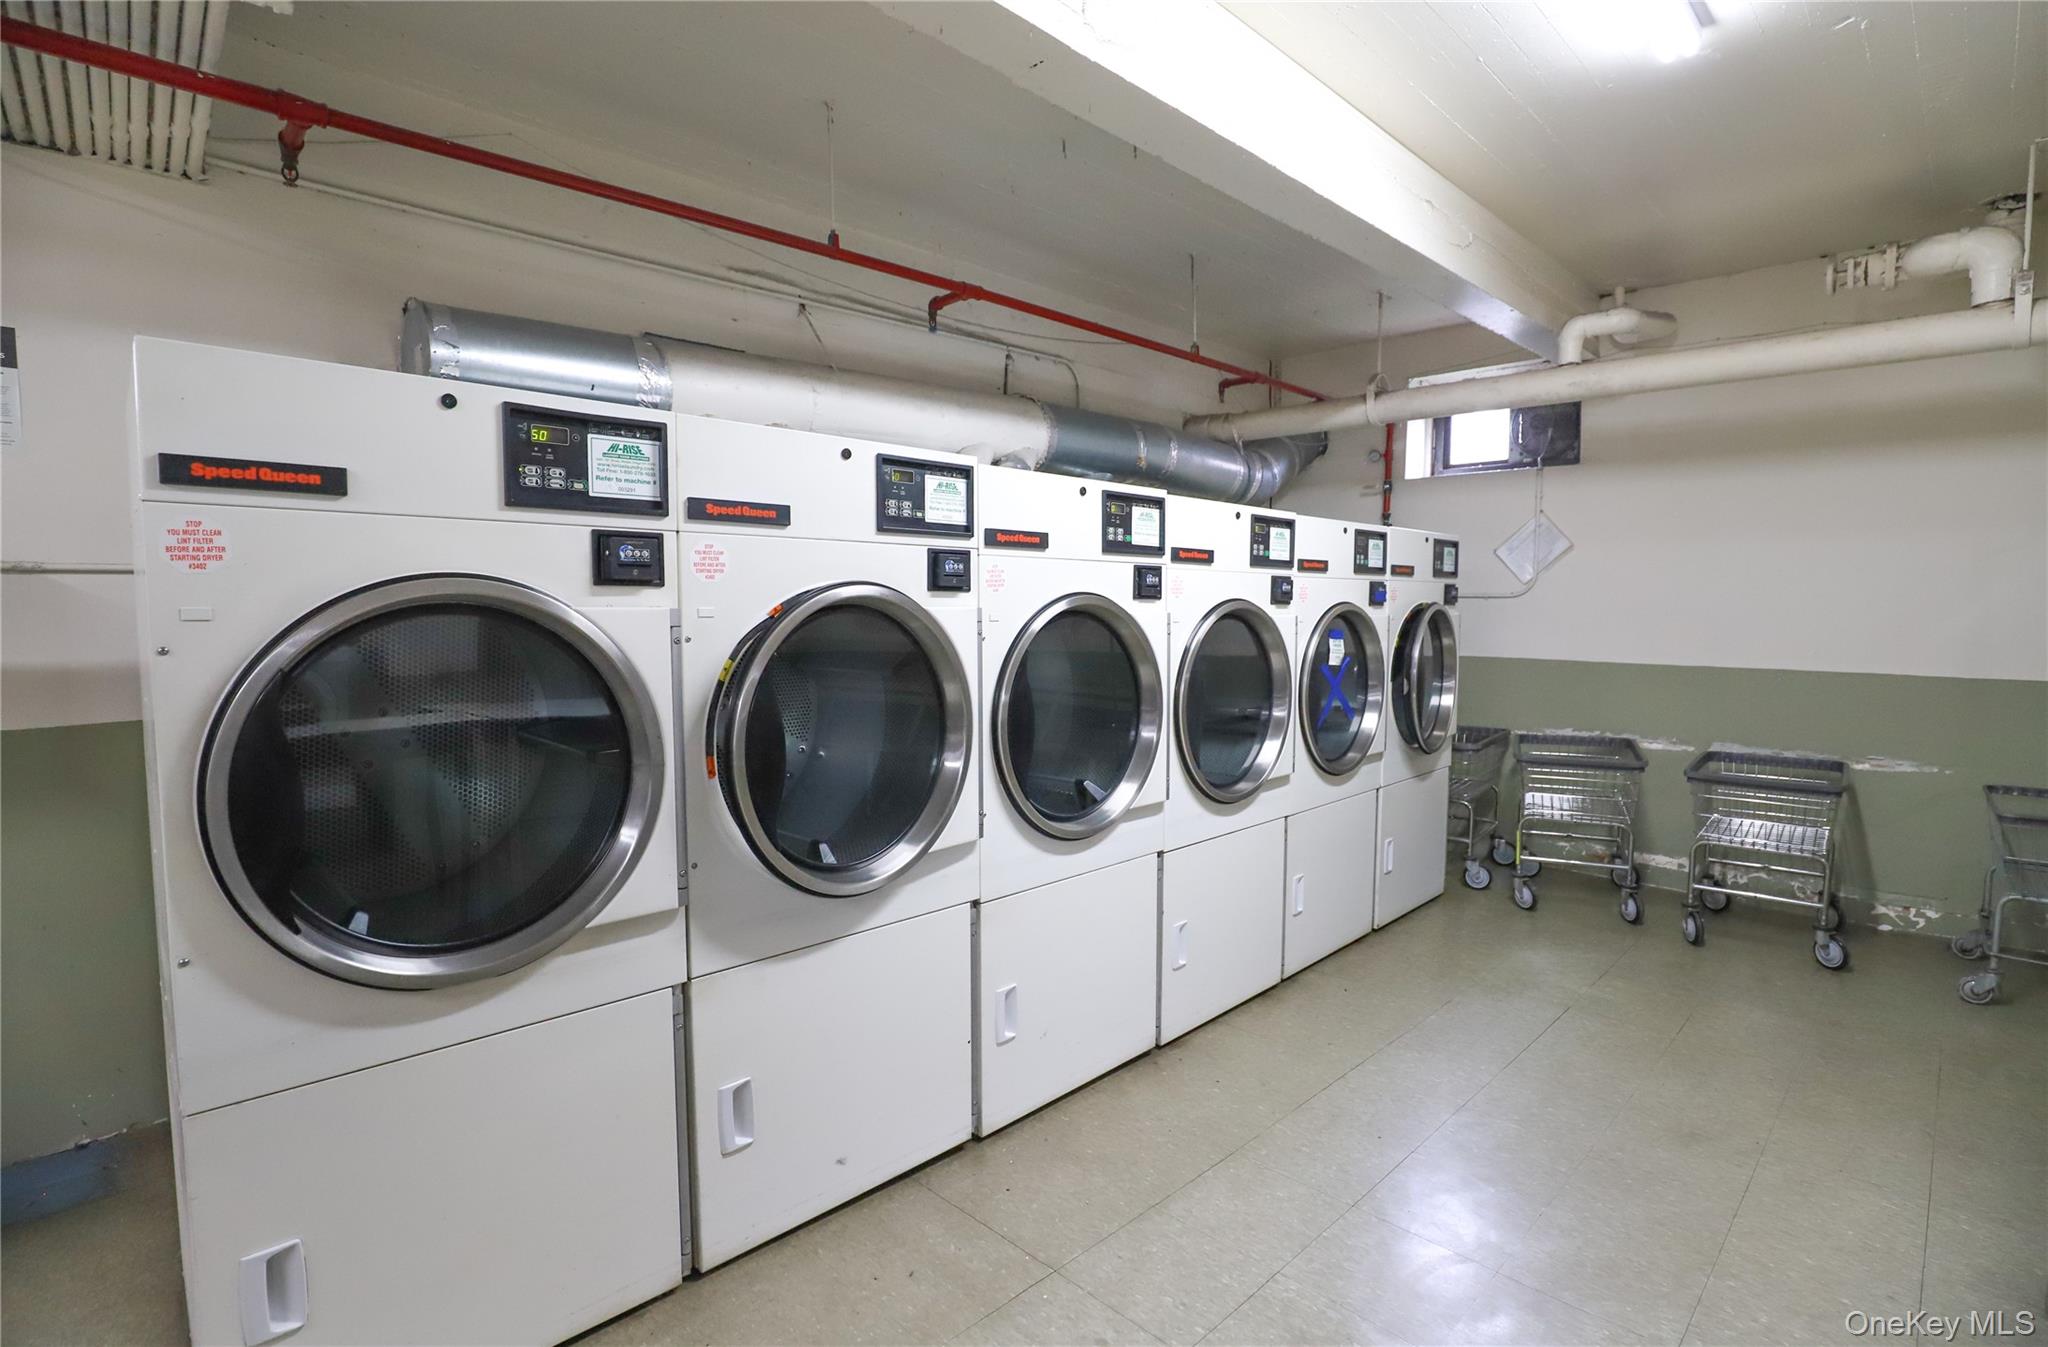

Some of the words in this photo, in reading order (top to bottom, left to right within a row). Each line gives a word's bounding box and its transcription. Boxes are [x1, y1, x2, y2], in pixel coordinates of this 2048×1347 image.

[531, 429, 547, 441] 50
[607, 442, 645, 456] HI-RISE
[190, 462, 257, 480] Speed
[258, 467, 321, 485] Queen
[623, 477, 651, 485] machine
[705, 503, 742, 516] Speed
[742, 506, 777, 518] Queen
[185, 520, 202, 528] STOP
[176, 537, 191, 545] LINT
[192, 537, 214, 545] FILTER
[996, 532, 1019, 543] Speed
[1019, 534, 1040, 544] Queen
[165, 545, 190, 553] BEFORE
[202, 554, 224, 562] DRYER
